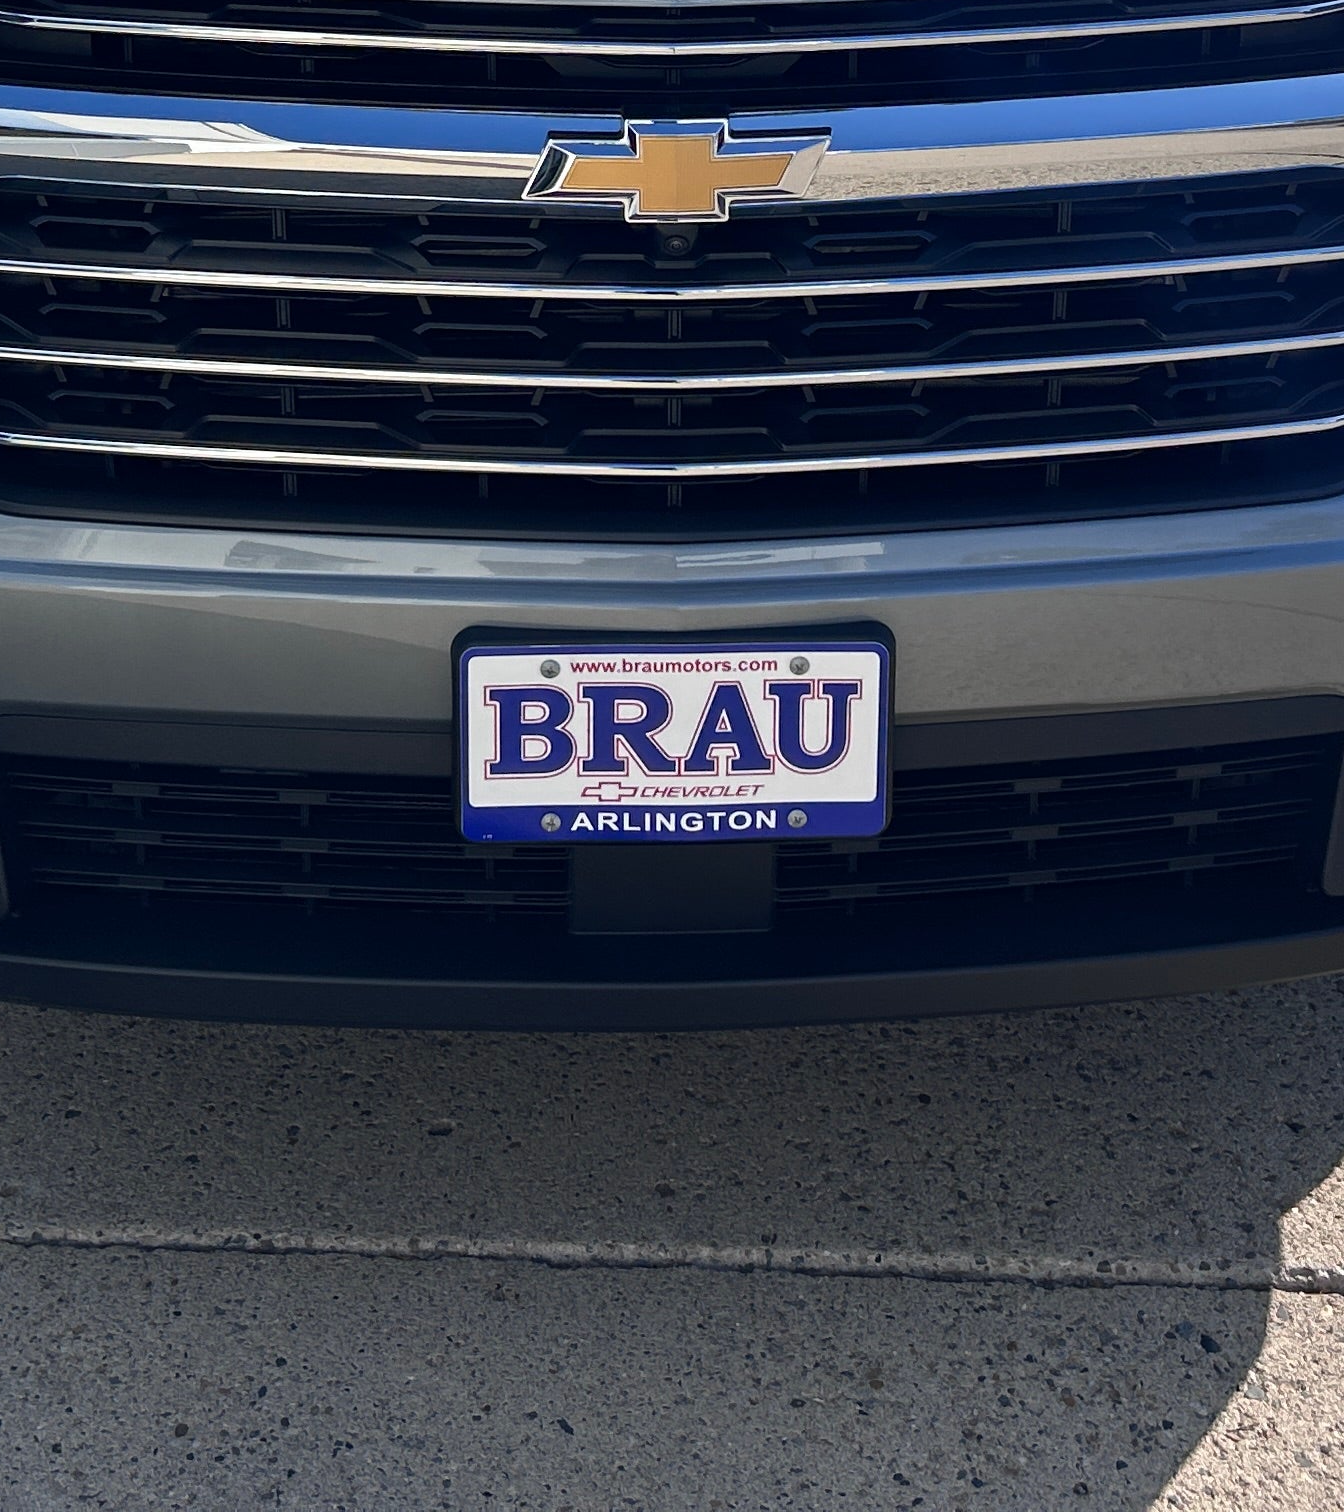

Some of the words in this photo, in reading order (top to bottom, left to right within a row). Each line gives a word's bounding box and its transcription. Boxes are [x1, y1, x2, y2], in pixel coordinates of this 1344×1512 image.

[570, 658, 778, 674] www.braumotors.com
[484, 679, 863, 780] BRAU
[640, 784, 765, 798] CHEVROLET
[570, 810, 778, 832] ARLINGTON
